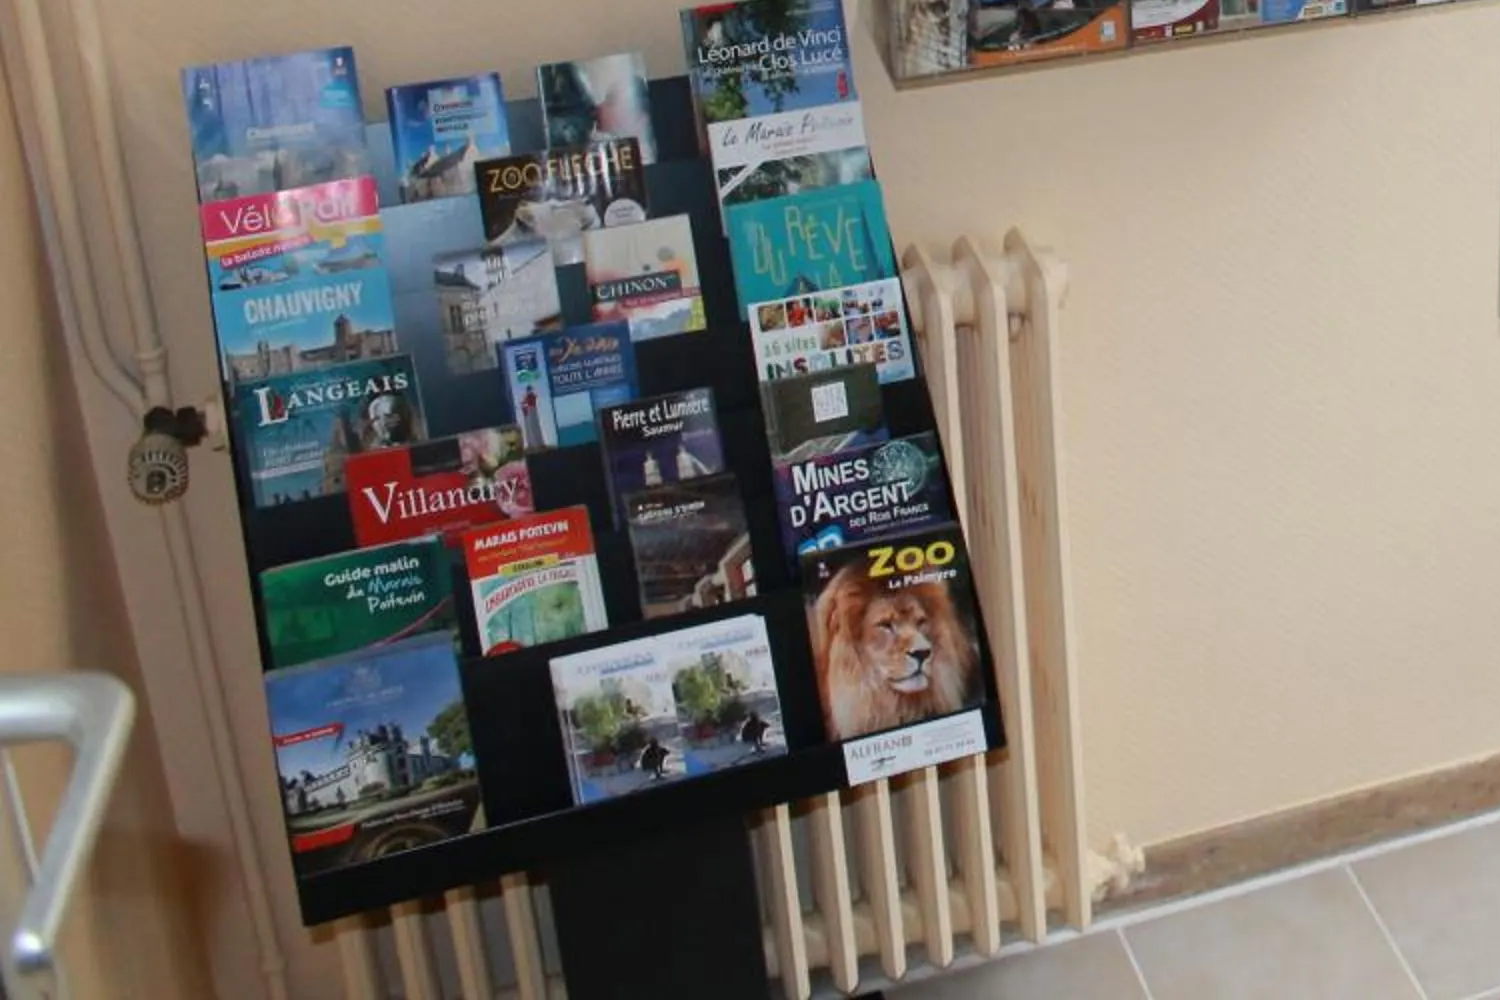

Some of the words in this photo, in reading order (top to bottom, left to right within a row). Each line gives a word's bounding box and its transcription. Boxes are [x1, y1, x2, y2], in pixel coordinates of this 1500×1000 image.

[697, 35, 769, 63] Léonard
[773, 32, 796, 51] de
[797, 25, 841, 47] Vinci
[759, 53, 797, 71] Clos
[800, 44, 843, 66] Lucé
[487, 162, 542, 194] ZOO
[596, 277, 668, 299] CHINON
[243, 283, 362, 324] CHAUVIGNY
[612, 407, 645, 431] Pierre
[649, 404, 661, 424] et
[362, 474, 520, 526] Villandry
[474, 529, 518, 552] MARAIS
[323, 566, 372, 587] Guide
[373, 555, 420, 576] malin
[867, 541, 956, 578] ZOO
[367, 572, 424, 595] Marais
[903, 566, 958, 589] Palmyre
[367, 588, 426, 614] Poitevin
